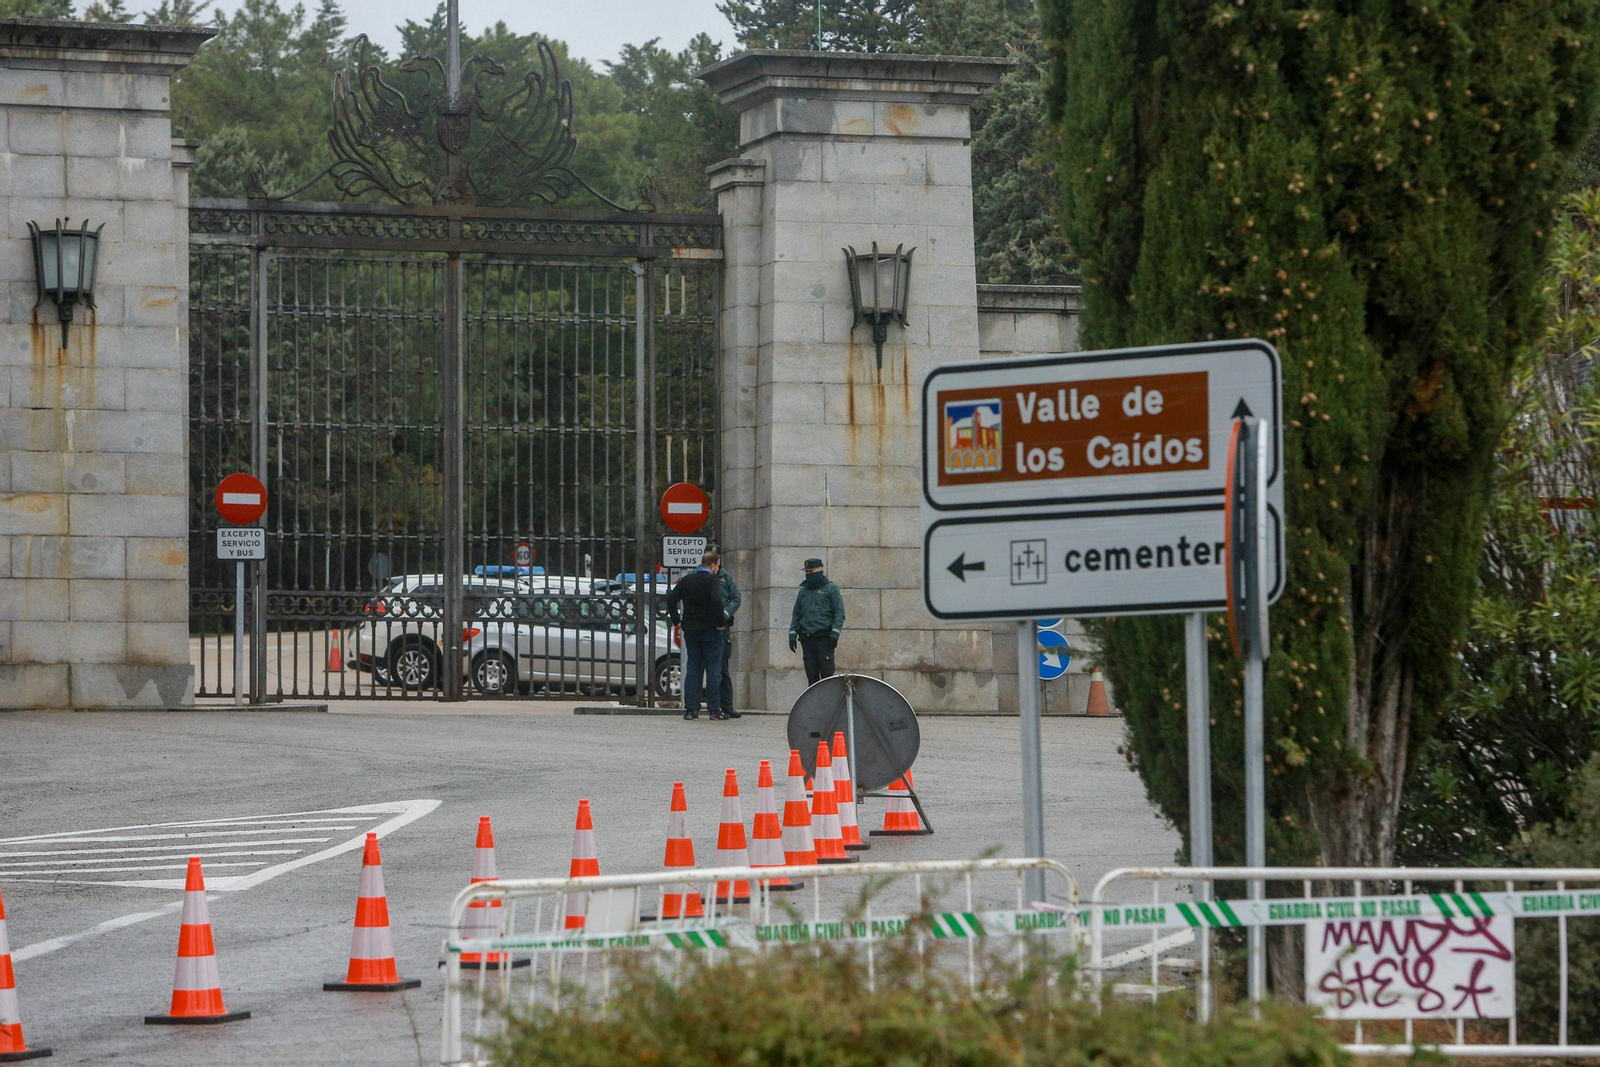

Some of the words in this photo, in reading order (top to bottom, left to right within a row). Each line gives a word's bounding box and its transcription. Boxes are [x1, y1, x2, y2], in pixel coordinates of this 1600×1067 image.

[1016, 389, 1100, 424] Valle
[1122, 385, 1164, 417] de
[1016, 442, 1065, 474] los
[1086, 432, 1204, 469] Caídos
[1065, 536, 1226, 573] cementer
[1104, 909, 1120, 925] NO
[1125, 907, 1166, 924] PASAR
[1361, 901, 1376, 916] NO
[1382, 900, 1421, 915] PASAR
[850, 921, 866, 937] NO
